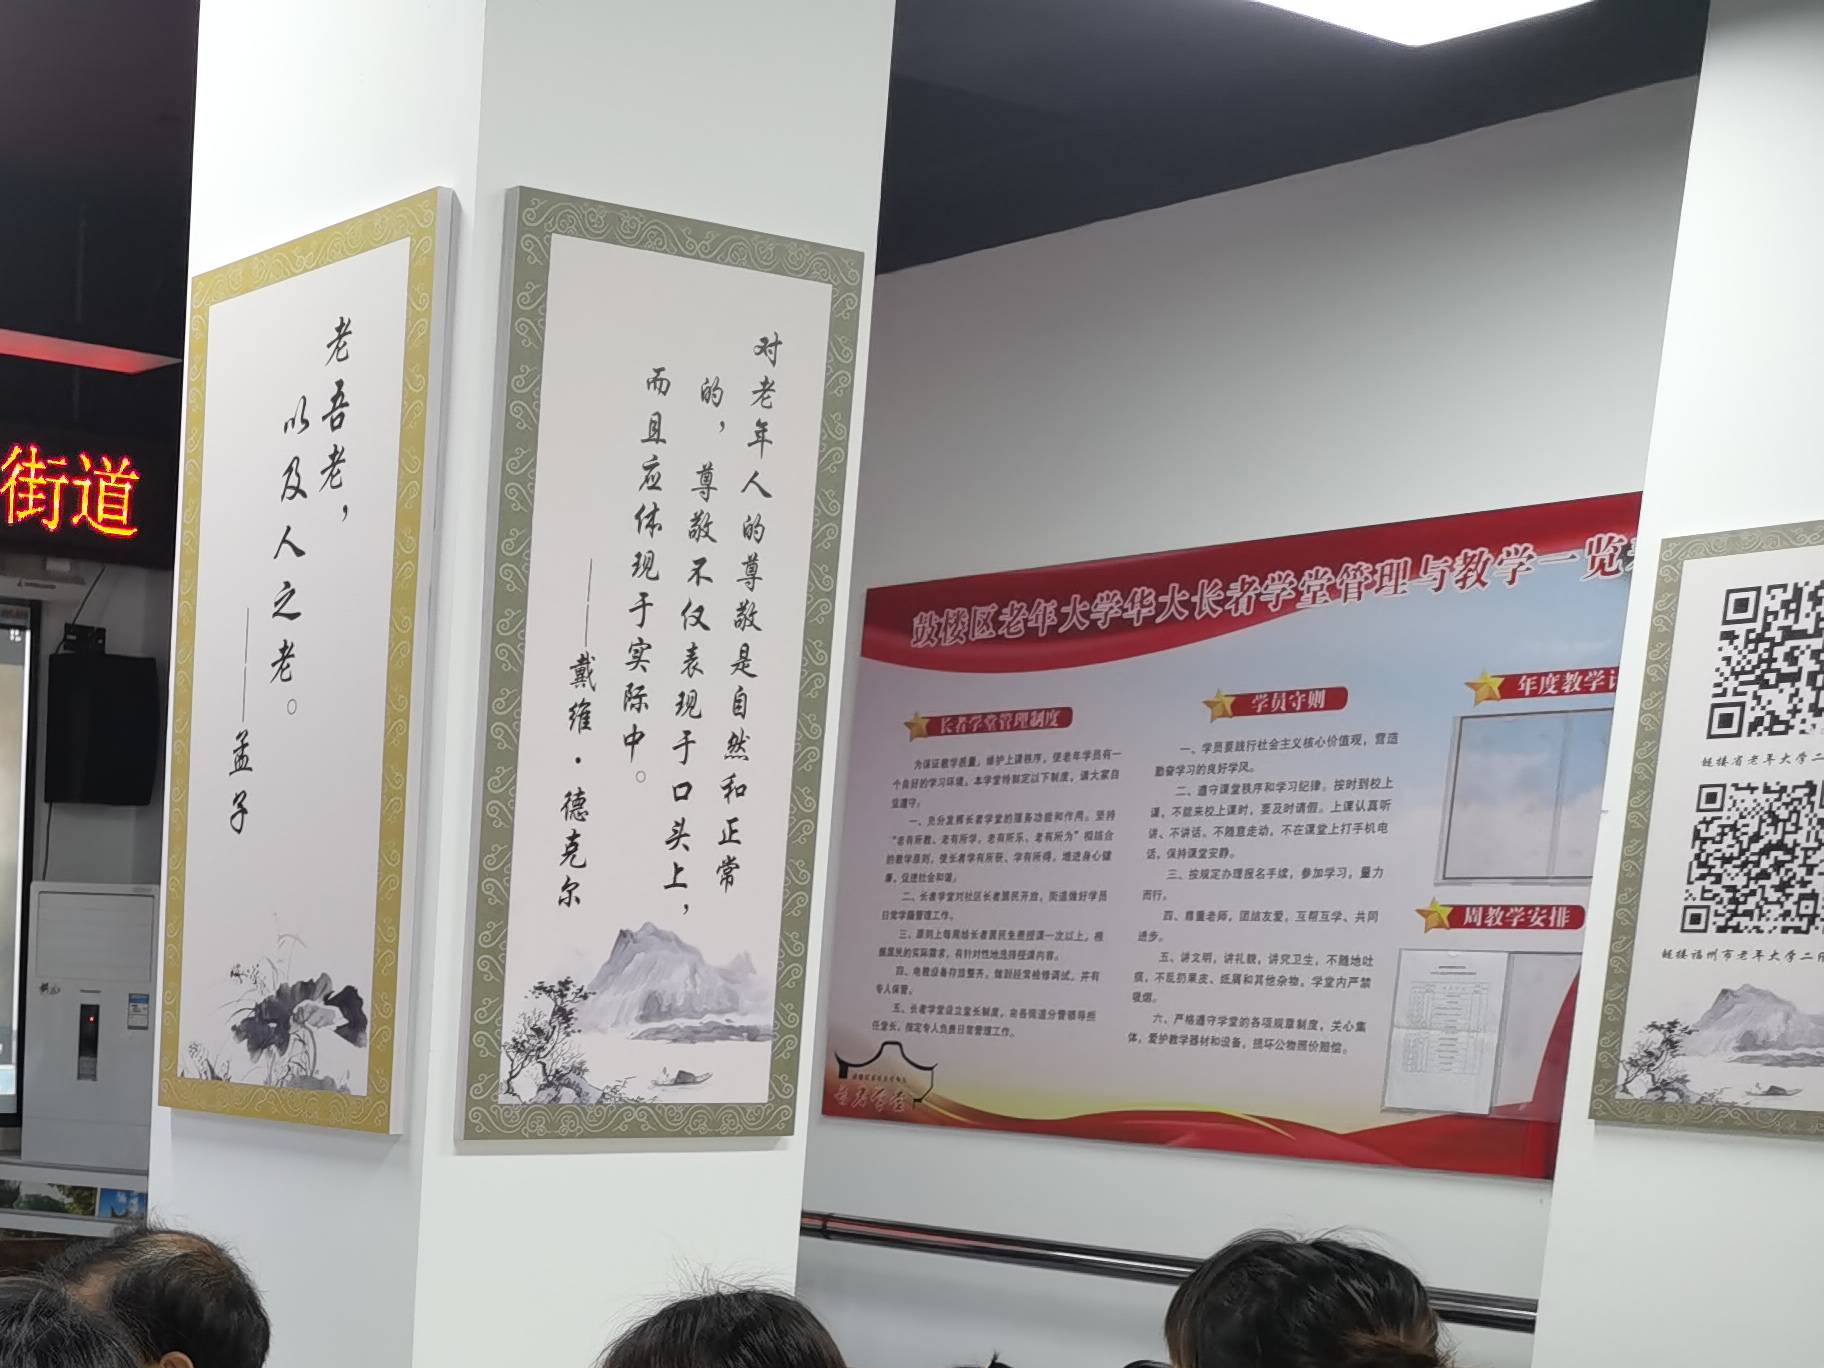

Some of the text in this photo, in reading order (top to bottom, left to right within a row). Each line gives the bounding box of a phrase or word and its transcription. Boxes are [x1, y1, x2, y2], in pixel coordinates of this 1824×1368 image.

[319, 315, 353, 524] 老吾老，
[270, 395, 311, 717] 以及人之老。
[622, 365, 672, 785] 而且应体现于实际中。
[662, 373, 725, 917] 的，尊敬不仅表现于口头上，
[715, 330, 784, 895] 对老年人的尊敬是自然和正常
[940, 709, 1061, 734] 长者学堂管理制度
[1252, 688, 1326, 713] 学员守则
[1463, 906, 1570, 928] 周教学安排
